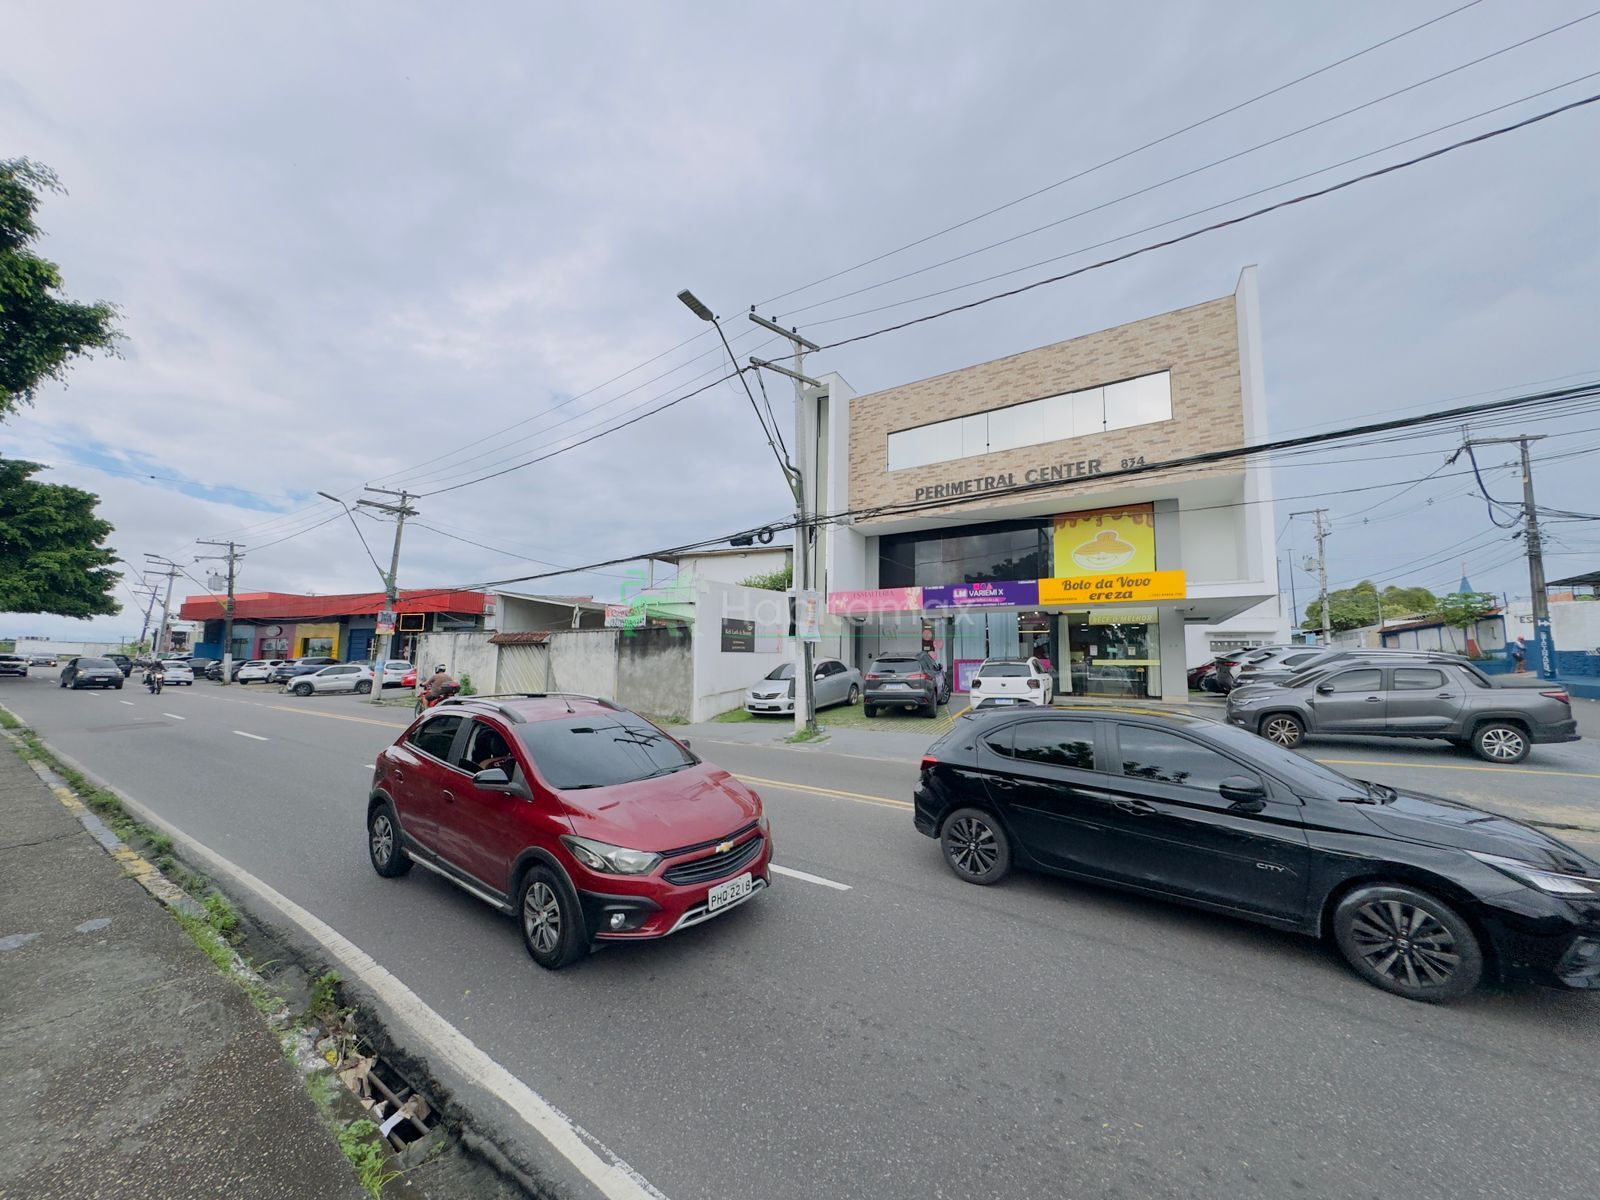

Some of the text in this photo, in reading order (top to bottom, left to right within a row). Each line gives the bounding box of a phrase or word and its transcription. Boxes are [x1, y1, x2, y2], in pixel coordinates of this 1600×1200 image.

[915, 472, 1017, 500] PERIMETRAL
[1025, 458, 1102, 484] CENTER
[1062, 576, 1151, 591] Bolo da Vovo
[1089, 590, 1133, 600] ereza
[1256, 862, 1285, 872] CITY
